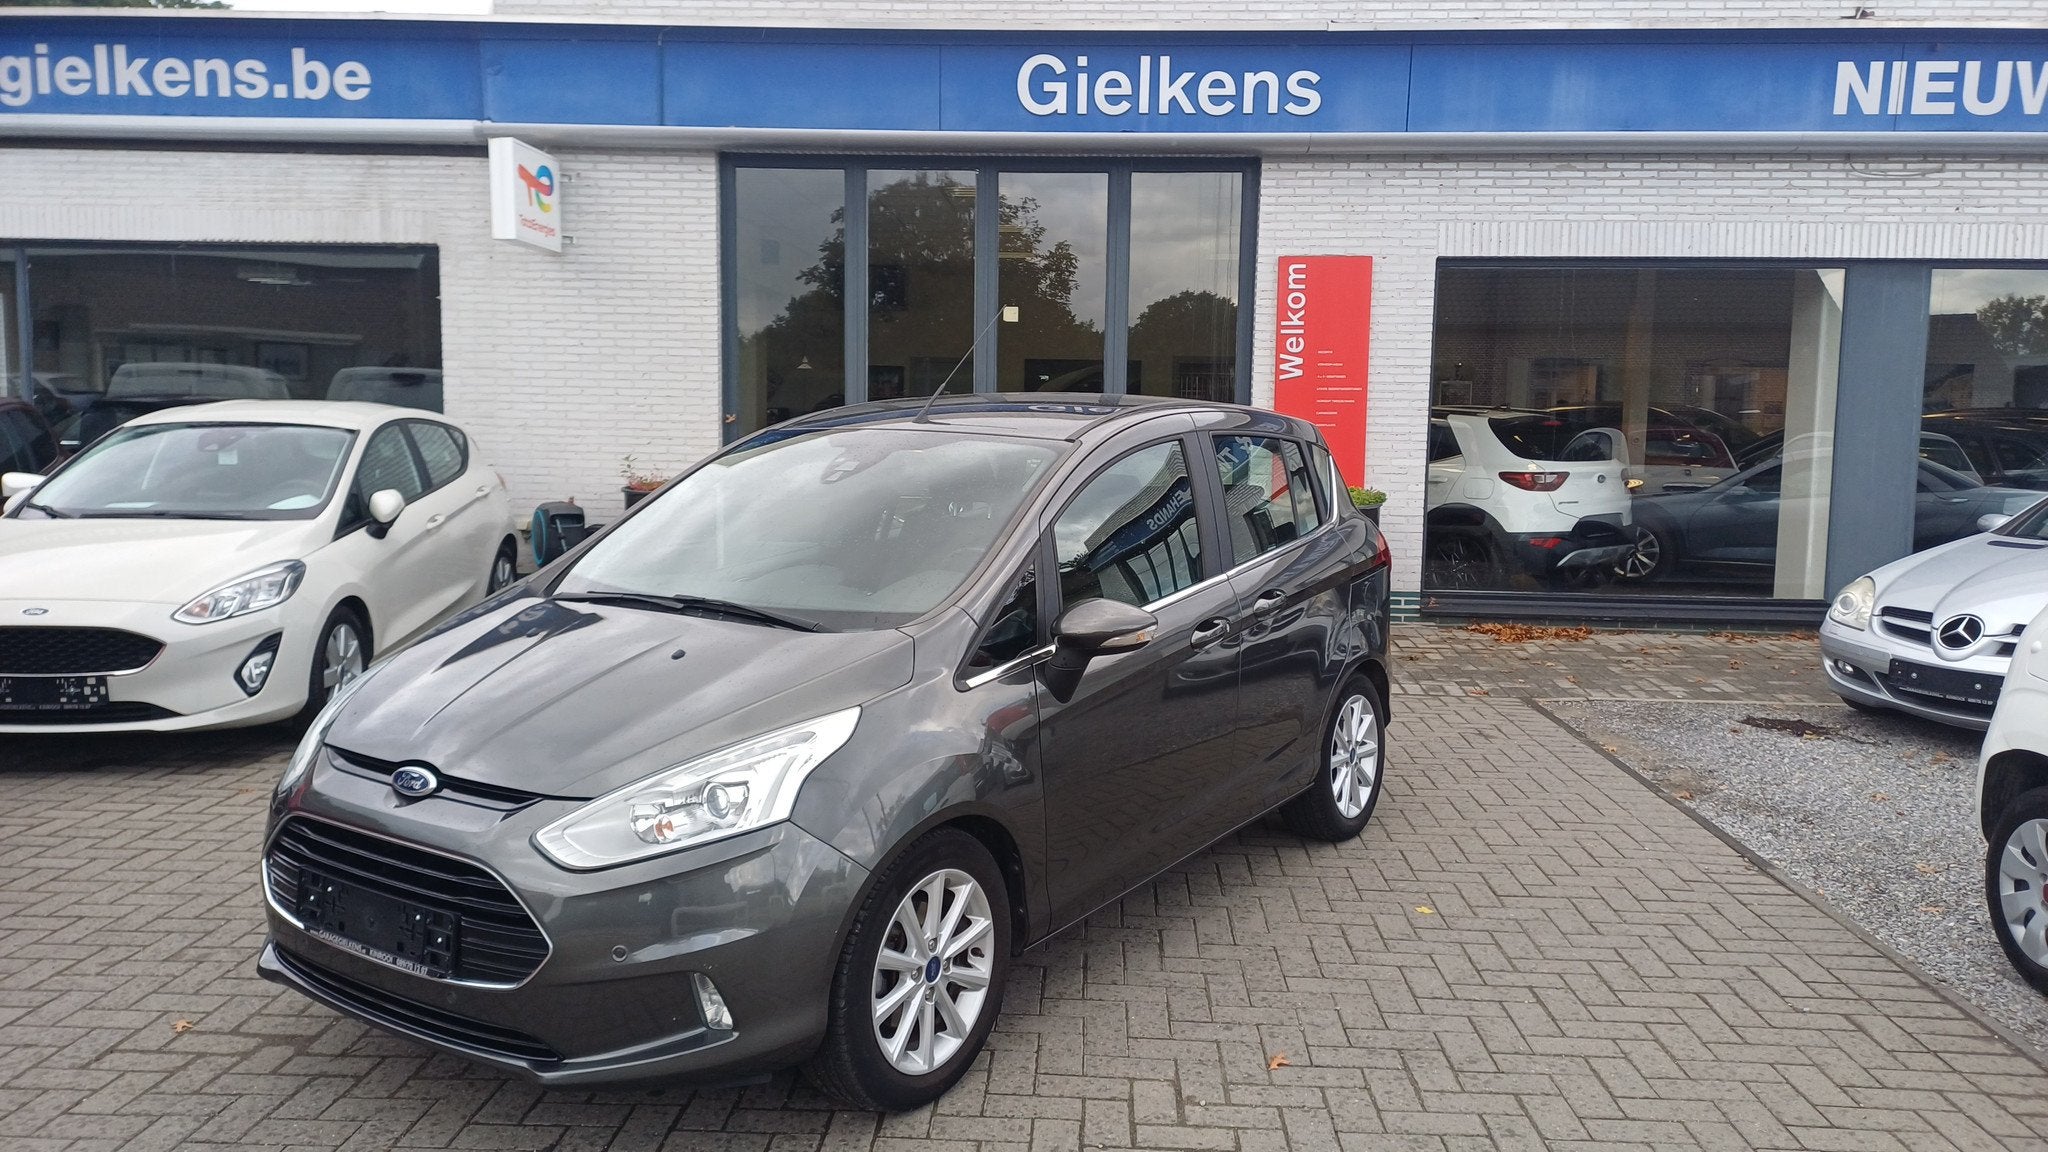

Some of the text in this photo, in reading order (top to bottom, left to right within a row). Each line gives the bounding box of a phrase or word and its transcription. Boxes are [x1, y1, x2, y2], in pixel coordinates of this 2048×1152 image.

[0, 43, 372, 106] gielkens.be
[1016, 53, 1322, 116] Gielkens
[1279, 263, 1307, 380] Welkom
[397, 771, 425, 790] Ford
